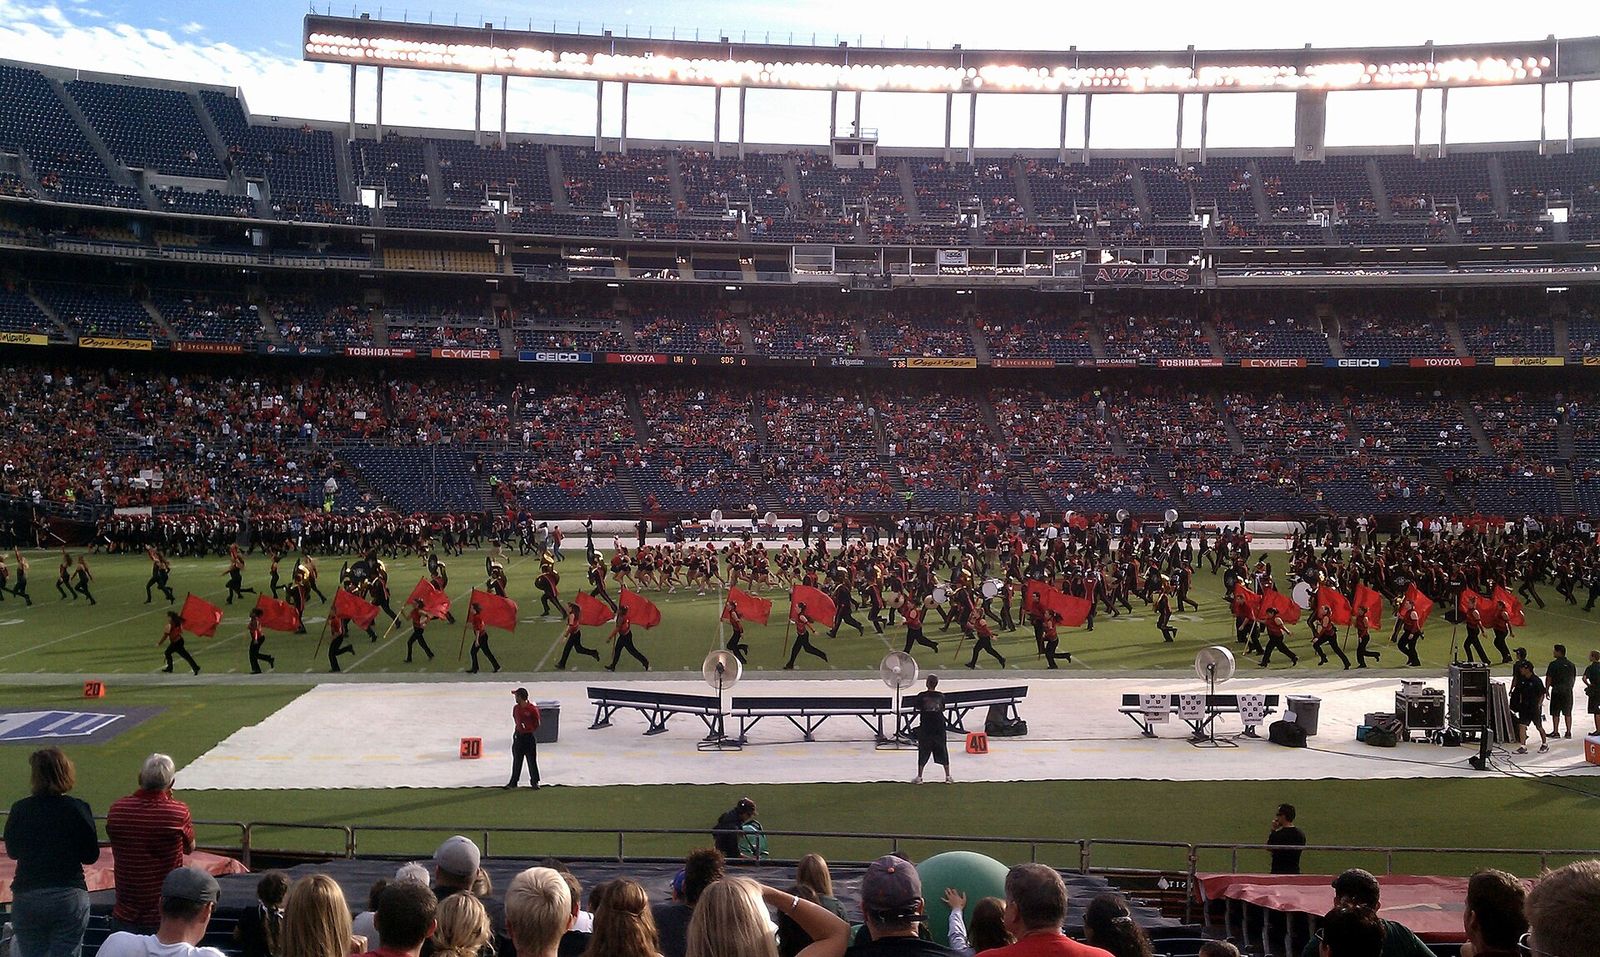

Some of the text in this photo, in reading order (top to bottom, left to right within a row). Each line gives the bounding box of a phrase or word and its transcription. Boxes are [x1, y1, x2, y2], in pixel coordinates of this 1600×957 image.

[348, 348, 390, 356] TOSHIBA
[441, 350, 490, 358] CYMER
[536, 352, 579, 361] GEICO
[619, 354, 655, 362] TOYOTA
[720, 356, 734, 364] SDS
[1250, 359, 1298, 367] CYMER
[1338, 359, 1379, 367] GEICO
[1424, 358, 1462, 366] TOYOTA
[85, 683, 100, 697] 20
[970, 735, 987, 751] 40
[462, 740, 480, 756] 30
